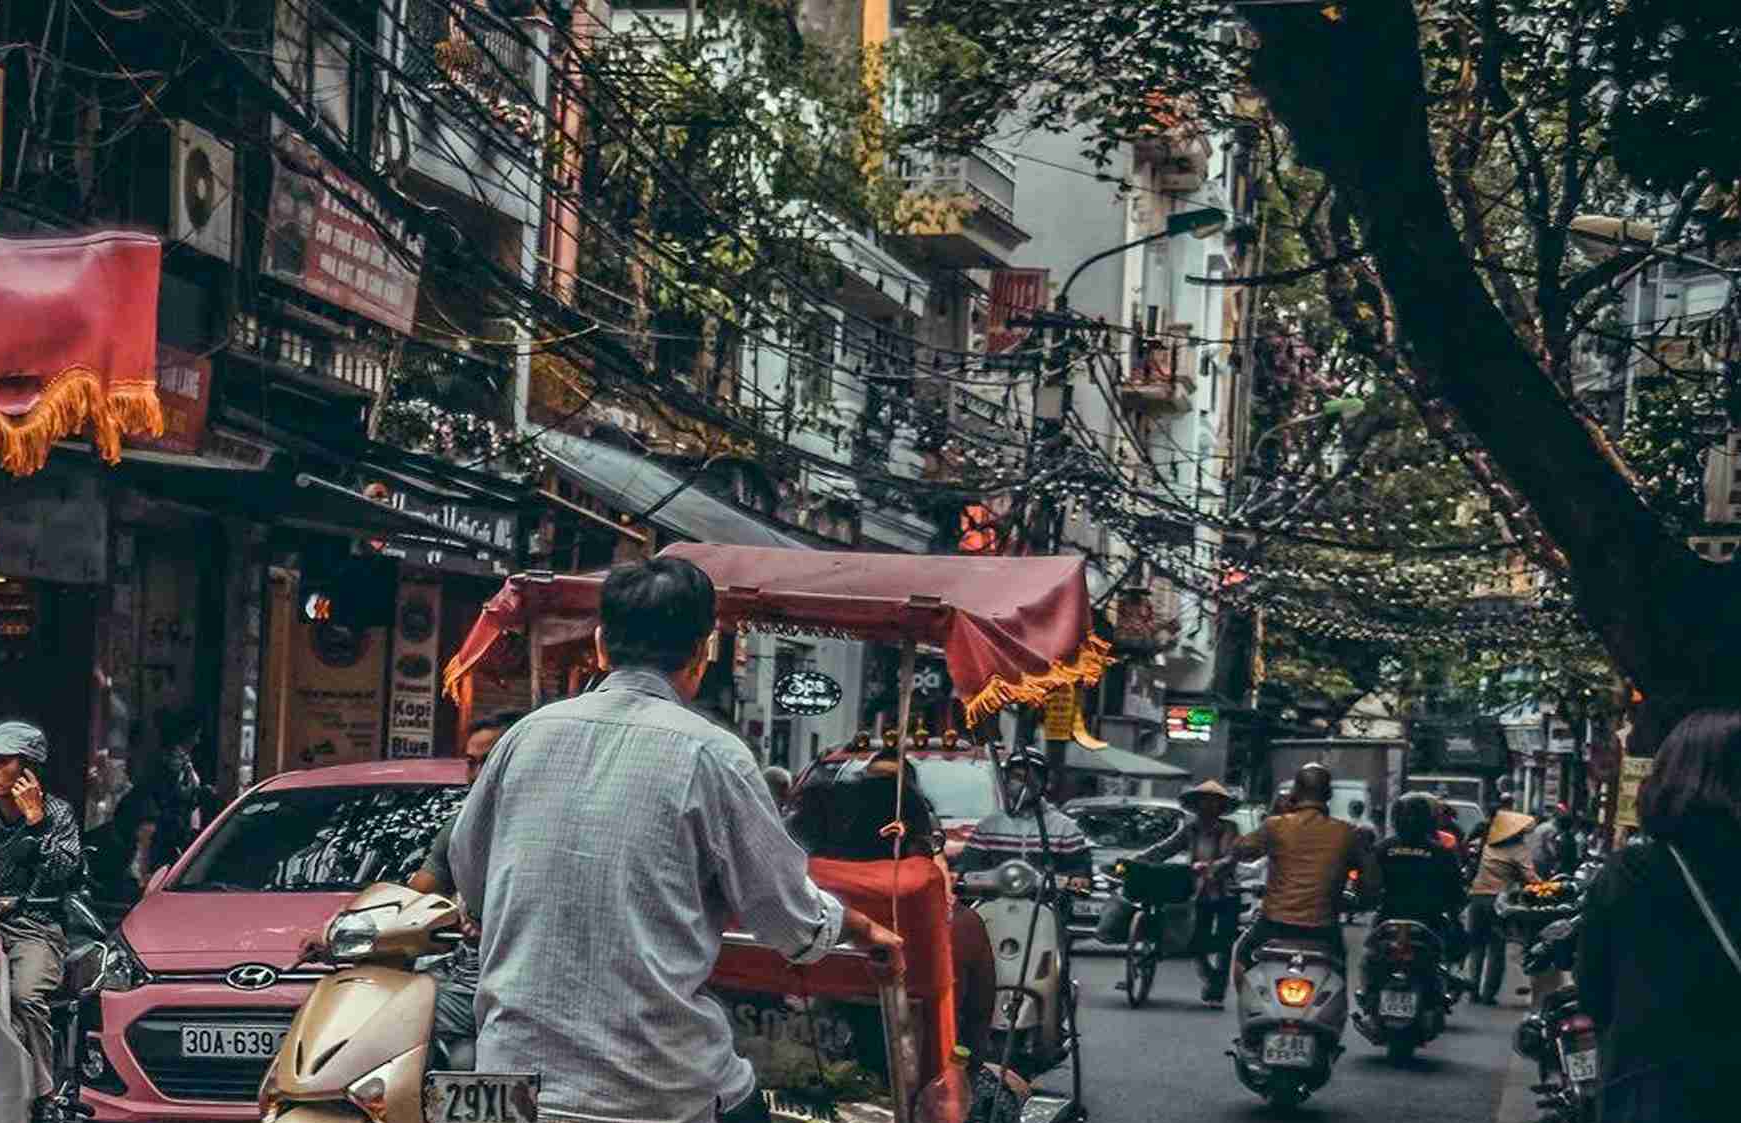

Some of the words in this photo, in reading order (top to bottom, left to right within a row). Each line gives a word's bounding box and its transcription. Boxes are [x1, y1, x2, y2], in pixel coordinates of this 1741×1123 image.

[393, 699, 431, 719] Kopi
[392, 736, 430, 754] Blue
[185, 1030, 289, 1055] 30A-639
[445, 1082, 517, 1123] 29XL
